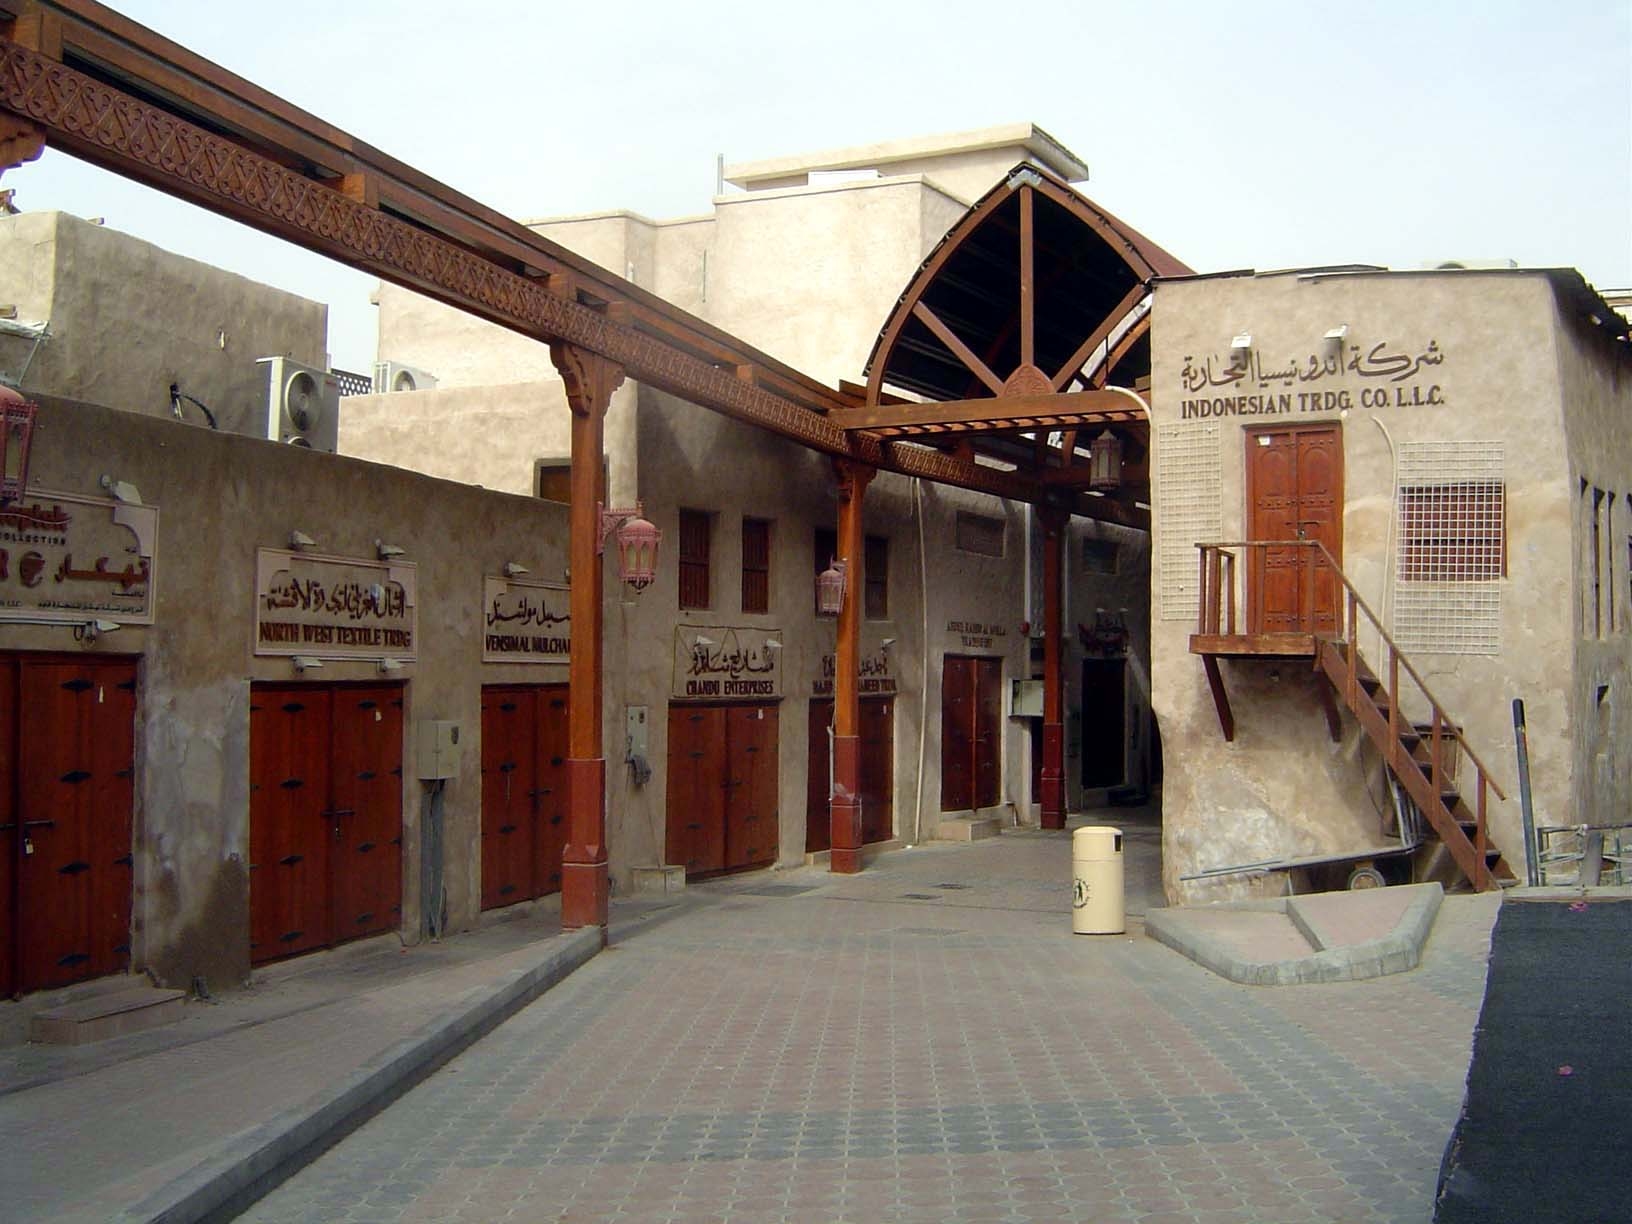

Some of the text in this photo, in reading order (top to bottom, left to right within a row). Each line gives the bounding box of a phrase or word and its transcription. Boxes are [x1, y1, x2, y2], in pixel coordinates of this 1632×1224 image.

[1347, 340, 1444, 382] شركة
[1181, 394, 1292, 418] INDONESIAN
[1297, 390, 1353, 412] TRDG.
[1360, 388, 1390, 409] CO.
[0, 530, 66, 545] OLLECTION
[260, 622, 299, 642] NORTH
[303, 623, 334, 643] WEST
[336, 626, 381, 646] TEXTILE
[532, 636, 571, 654] MULCHA
[724, 680, 774, 695] ENTERPRISES
